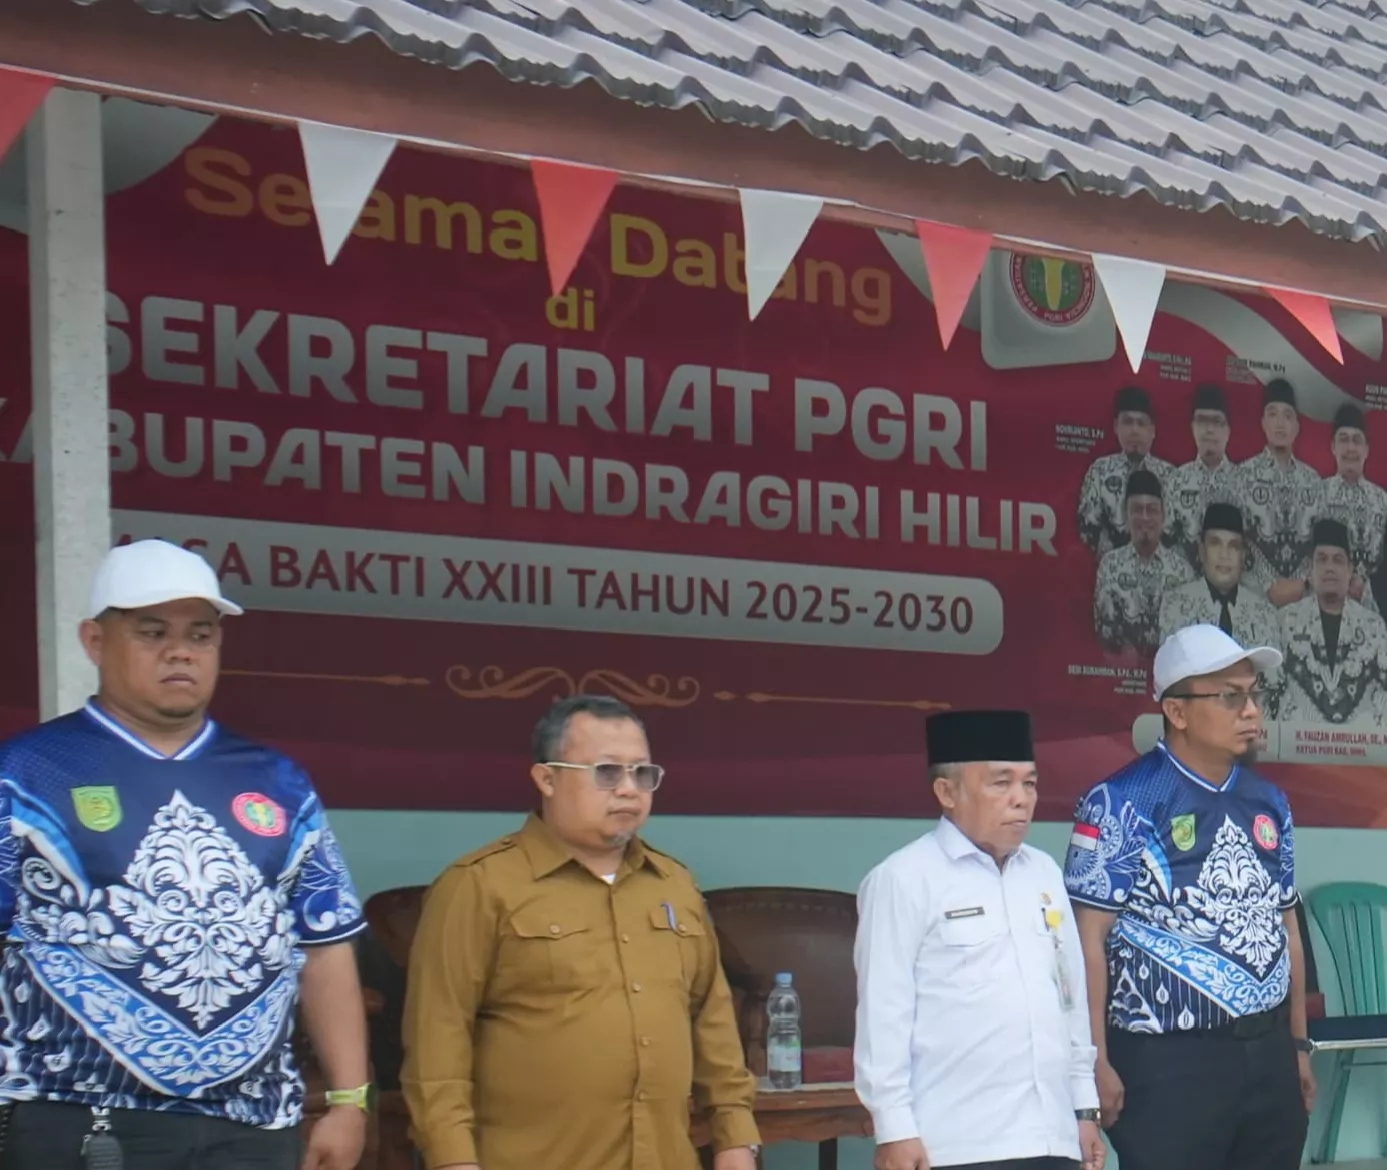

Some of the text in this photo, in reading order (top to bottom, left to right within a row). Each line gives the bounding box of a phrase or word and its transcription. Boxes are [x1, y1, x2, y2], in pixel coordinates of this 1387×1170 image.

[184, 145, 538, 262] Seama
[546, 287, 595, 331] di
[794, 376, 987, 472] PGRI
[0, 398, 1059, 557] BUPATEN INDRAGIRI HILIR
[269, 544, 425, 598] BAKTI
[442, 556, 552, 605] XXIII
[567, 567, 730, 618] TAHUN
[745, 580, 974, 636] 2025-2030
